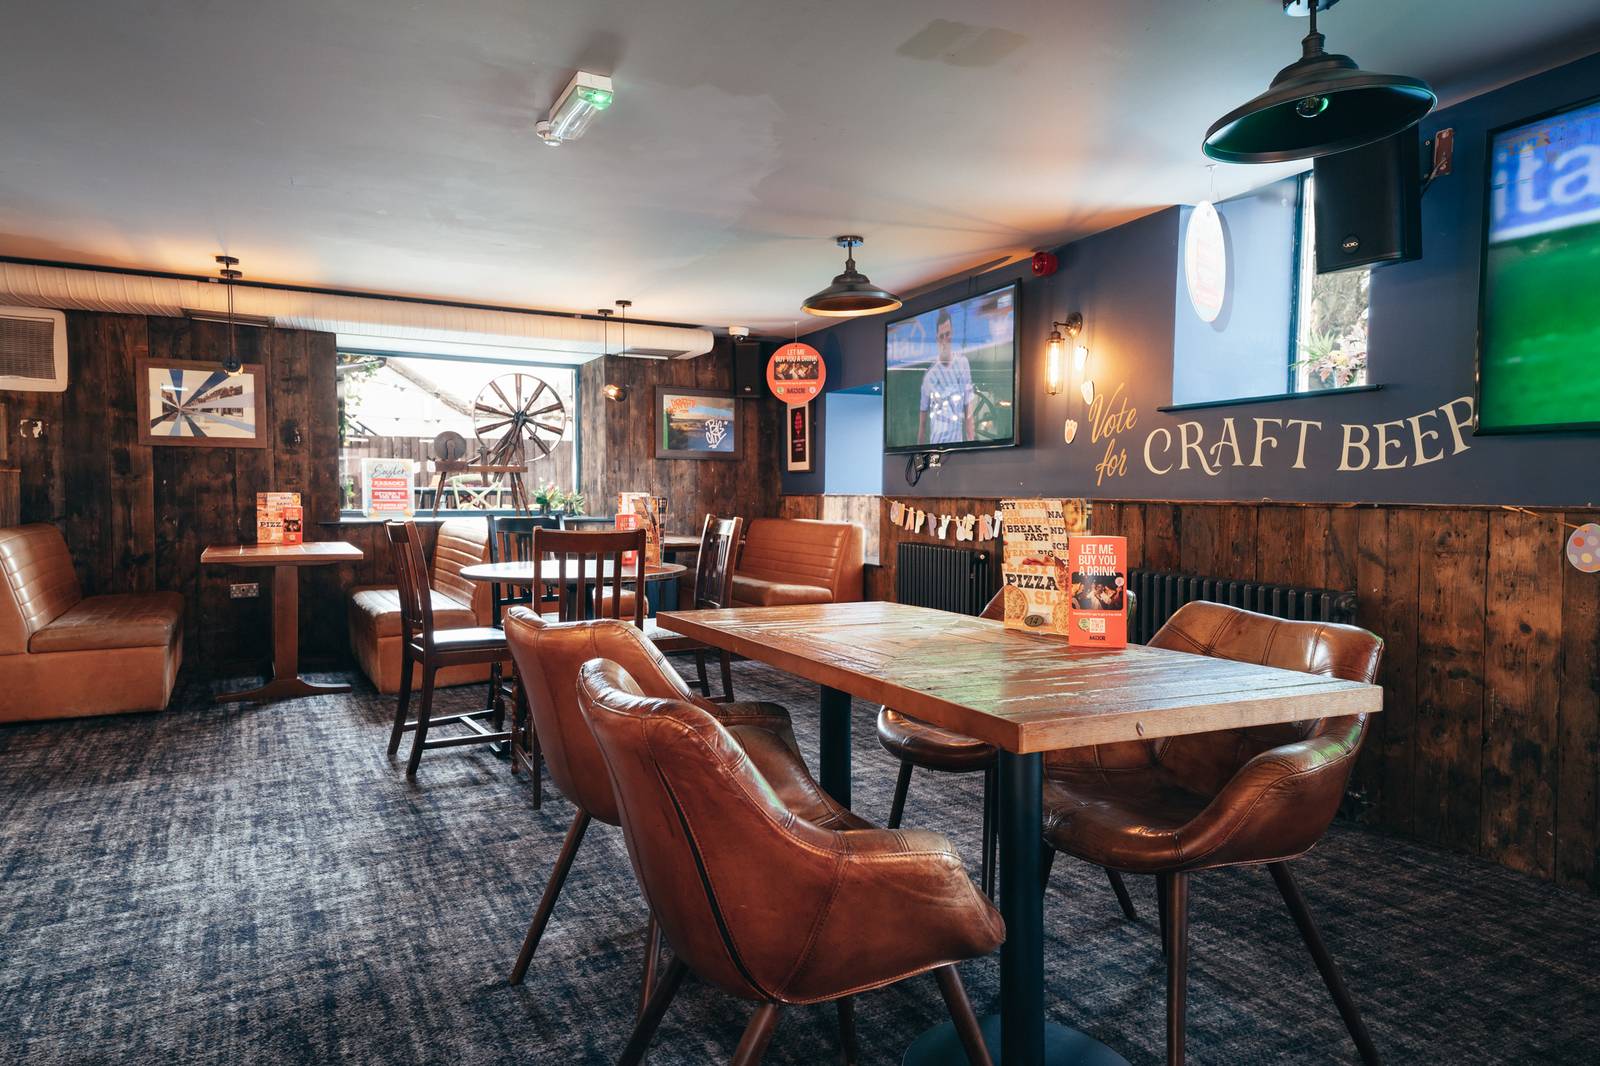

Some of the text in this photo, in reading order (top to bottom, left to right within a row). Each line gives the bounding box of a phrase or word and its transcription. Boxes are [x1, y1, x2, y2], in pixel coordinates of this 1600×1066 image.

[1089, 382, 1137, 444] Vote
[1143, 417, 1322, 477] CRAFT
[1095, 438, 1127, 487] for
[1024, 533, 1049, 541] FAST
[1081, 544, 1114, 554] LET ME
[1079, 555, 1096, 565] BUY
[1098, 555, 1117, 566] YOU
[1079, 565, 1117, 576] A DRINK
[1005, 573, 1060, 591] PIZZA
